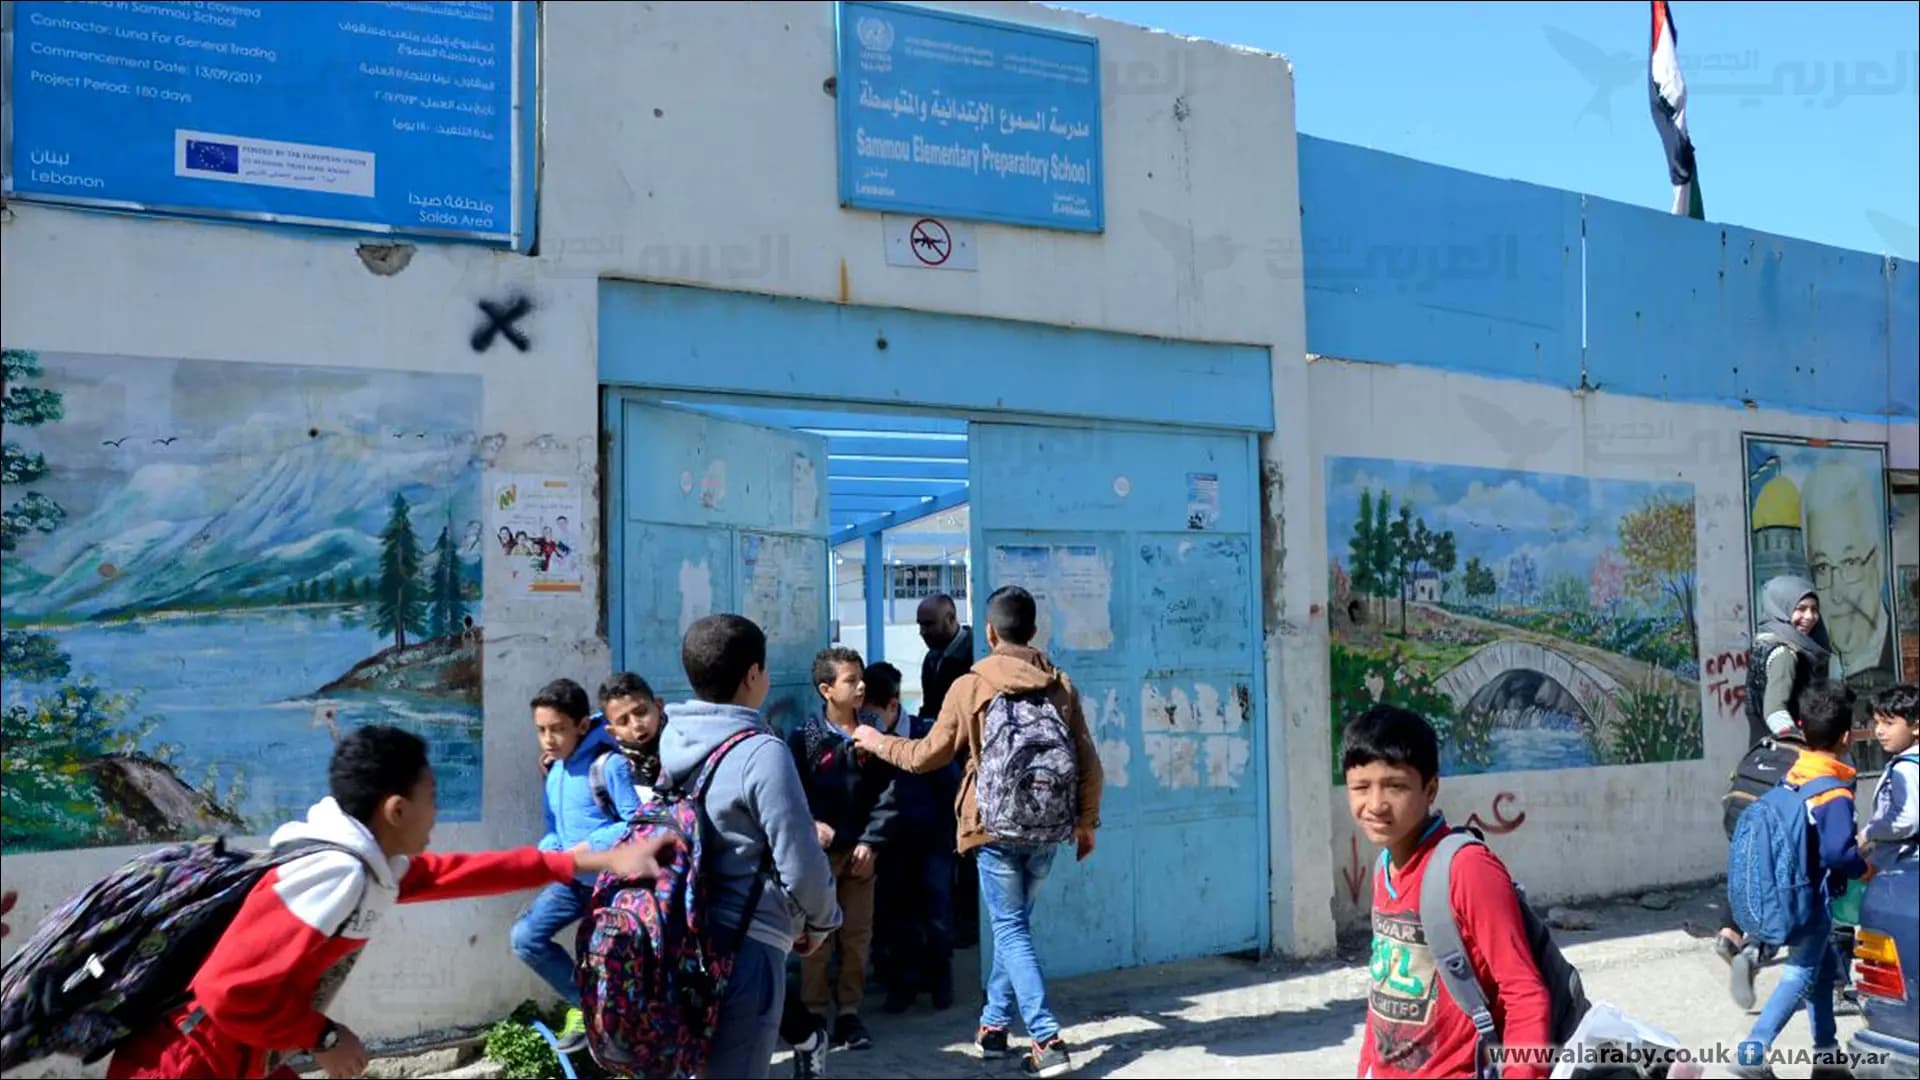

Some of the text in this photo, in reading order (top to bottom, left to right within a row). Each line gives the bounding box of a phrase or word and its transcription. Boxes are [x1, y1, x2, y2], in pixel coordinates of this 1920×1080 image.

[193, 10, 238, 28] School
[115, 26, 149, 41] Luna
[151, 31, 172, 44] For
[174, 34, 229, 54] General
[230, 42, 278, 62] Trading
[30, 41, 151, 70] Commencement
[195, 65, 263, 85] 13/09/2017
[30, 70, 80, 89] Project
[136, 84, 159, 99] 180
[160, 88, 193, 105] days
[859, 79, 928, 122] والمتوسطة
[999, 107, 1046, 136] السموع
[1048, 104, 1091, 141] مدرسة
[30, 149, 71, 167] لبنان
[855, 127, 1092, 185] Sammou Elementary Preparatory School
[30, 168, 106, 189] Lebanon
[408, 191, 495, 214] منطقة صيدا
[460, 214, 495, 230] Area
